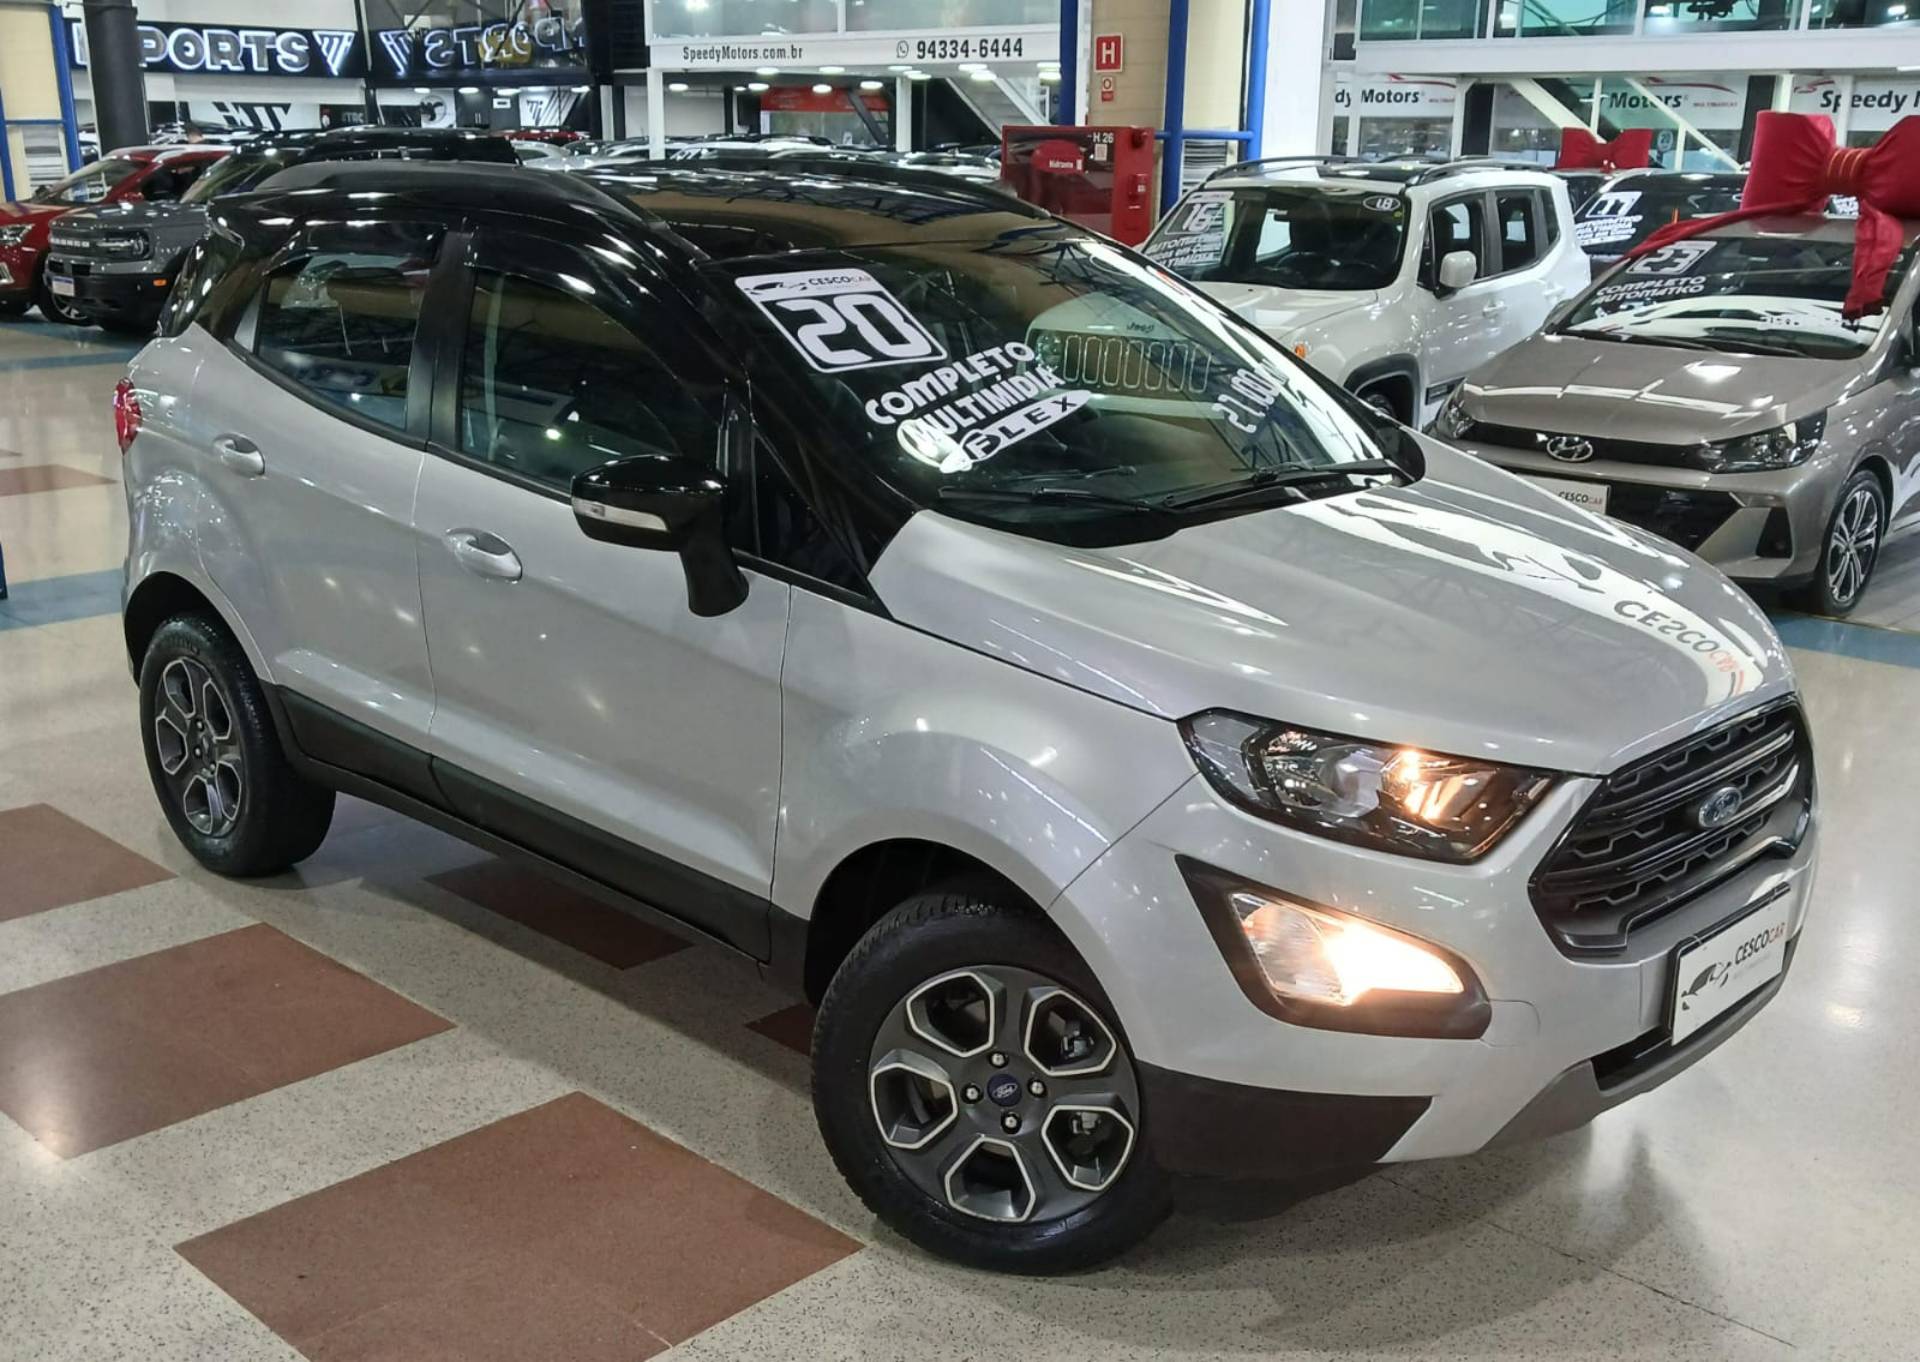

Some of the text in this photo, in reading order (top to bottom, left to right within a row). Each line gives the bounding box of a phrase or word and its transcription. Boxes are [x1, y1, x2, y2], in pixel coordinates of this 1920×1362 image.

[683, 45, 803, 62] SpeedyMotors.com.br
[917, 38, 1023, 59] 94334-6444
[1102, 42, 1115, 64] H
[1361, 88, 1420, 103] Motors
[1093, 132, 1114, 144] H 26
[1635, 248, 1701, 273] 23
[1596, 276, 1706, 296] COMPLETO
[775, 294, 932, 365] 20
[865, 342, 1035, 425] COMPLETO
[966, 396, 1078, 459] FLEX
